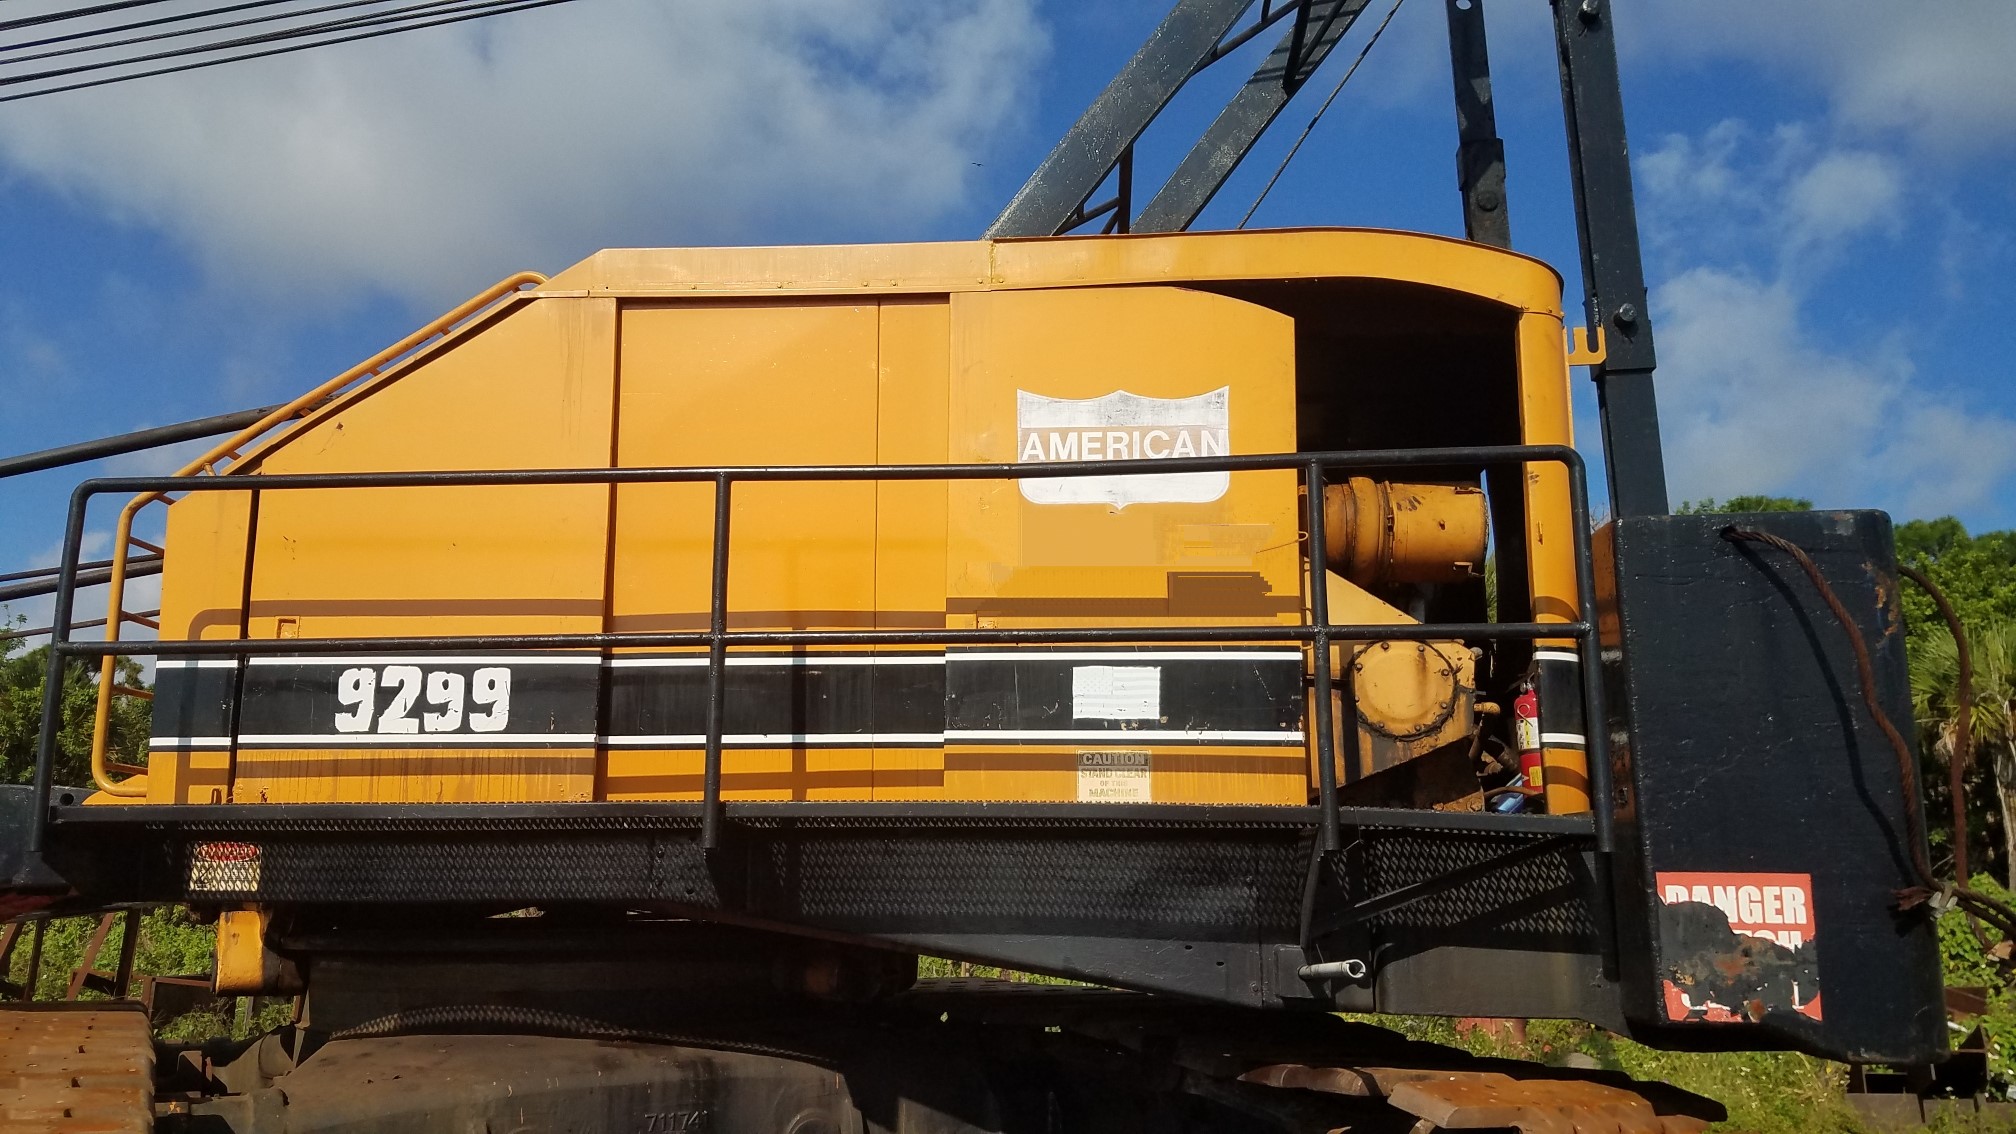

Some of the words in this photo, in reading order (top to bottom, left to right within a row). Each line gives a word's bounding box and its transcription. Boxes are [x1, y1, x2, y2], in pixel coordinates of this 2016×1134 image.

[1021, 430, 1225, 461] AMERICAN
[335, 665, 511, 734] 9299
[1082, 753, 1146, 765] CAUTION
[1081, 768, 1113, 779] STAND
[1115, 768, 1147, 779] CLEAR
[1089, 788, 1139, 798] MACHINE
